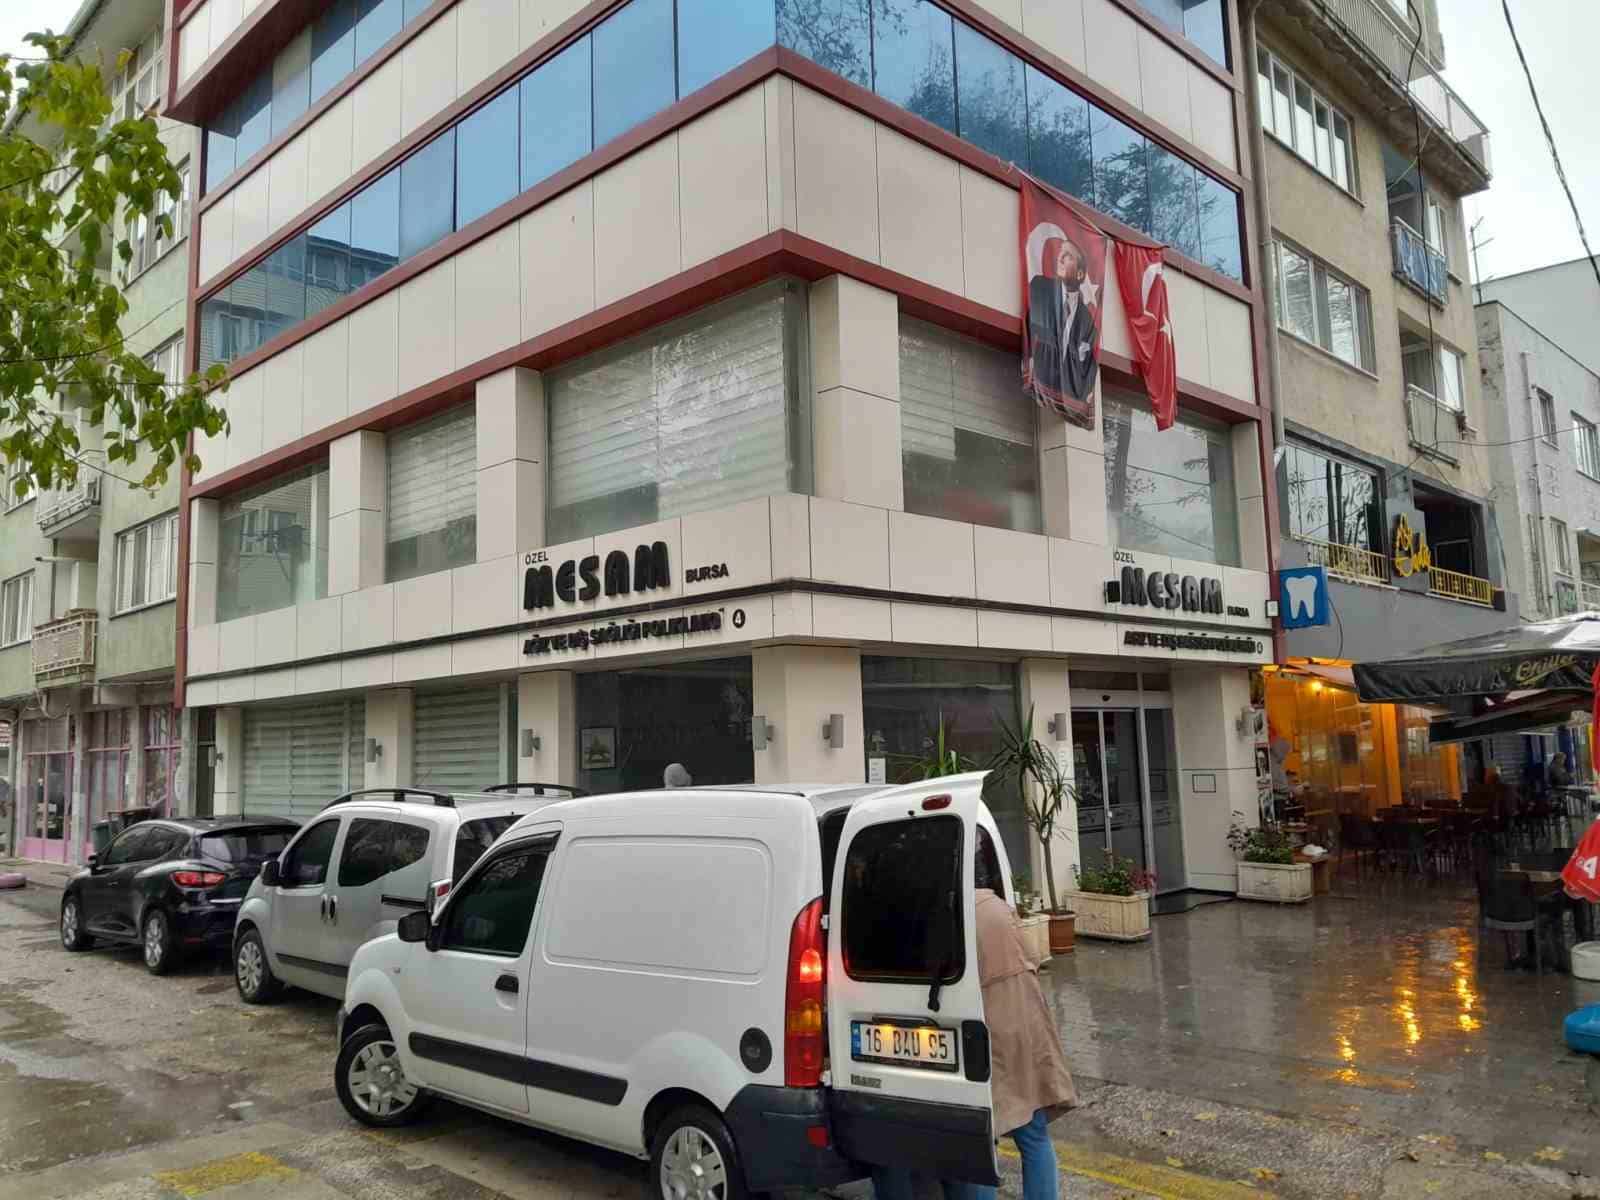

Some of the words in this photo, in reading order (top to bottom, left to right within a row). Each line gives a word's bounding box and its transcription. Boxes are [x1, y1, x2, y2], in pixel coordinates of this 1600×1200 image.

[523, 541, 671, 611] MESAM
[685, 563, 729, 584] BURSA
[1121, 565, 1224, 615] MESAM
[866, 1028, 882, 1053] 16
